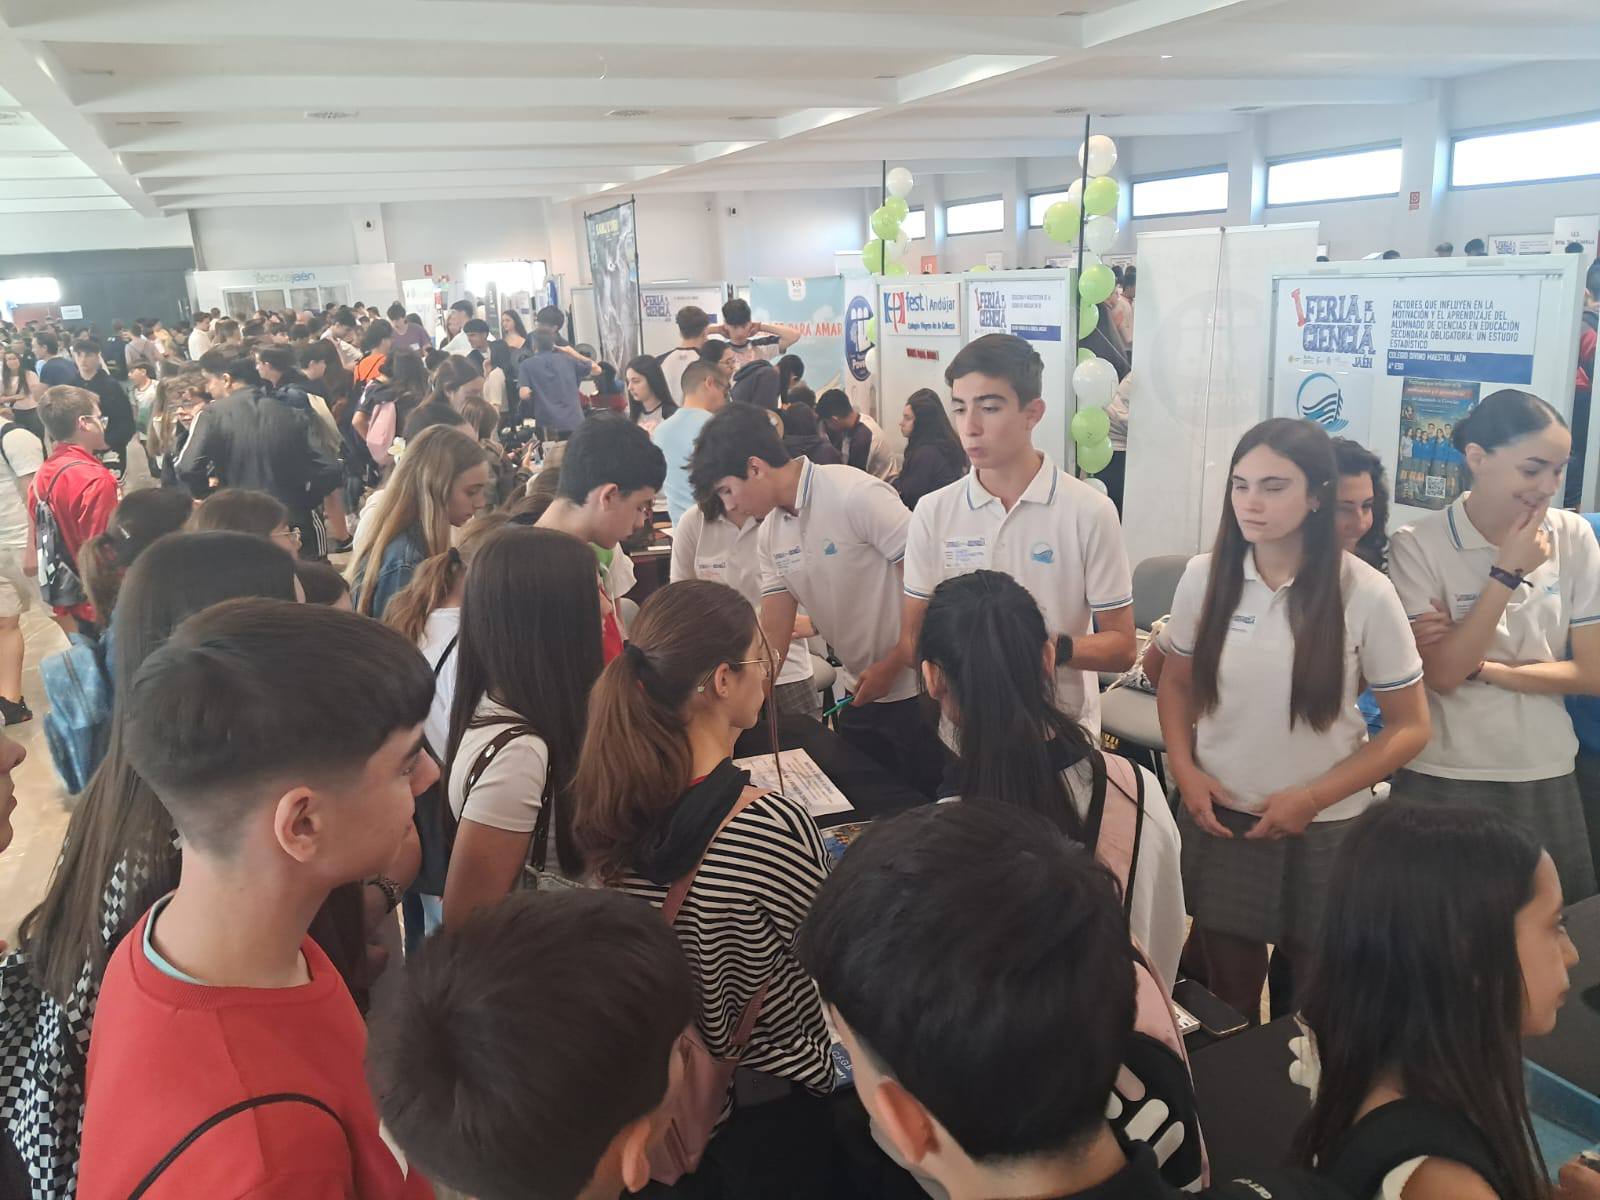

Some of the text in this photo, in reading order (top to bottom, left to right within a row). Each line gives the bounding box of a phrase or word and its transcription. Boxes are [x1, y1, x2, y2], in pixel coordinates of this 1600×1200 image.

[929, 295, 956, 313] Andújar
[980, 290, 1000, 309] FERIA
[1392, 299, 1494, 310] FACTORES QUE INFLUYEN EN LA
[1305, 294, 1375, 324] FERIA DE
[1391, 309, 1508, 321] MOTIVACIÓN Y EL APRENDIZAJE DEL
[980, 308, 1007, 328] CIENCIA
[1363, 311, 1377, 324] LA
[815, 322, 842, 337] AMAR
[1390, 319, 1520, 332] ALUMNADO DE CIENCIAS EN EDUCACIÓN
[1302, 323, 1377, 355] CIENCIA
[1390, 330, 1429, 340] SECUNDARIA
[1476, 331, 1487, 342] UN
[1488, 332, 1520, 343] ESTUDIO
[1351, 354, 1373, 369] JAÉN
